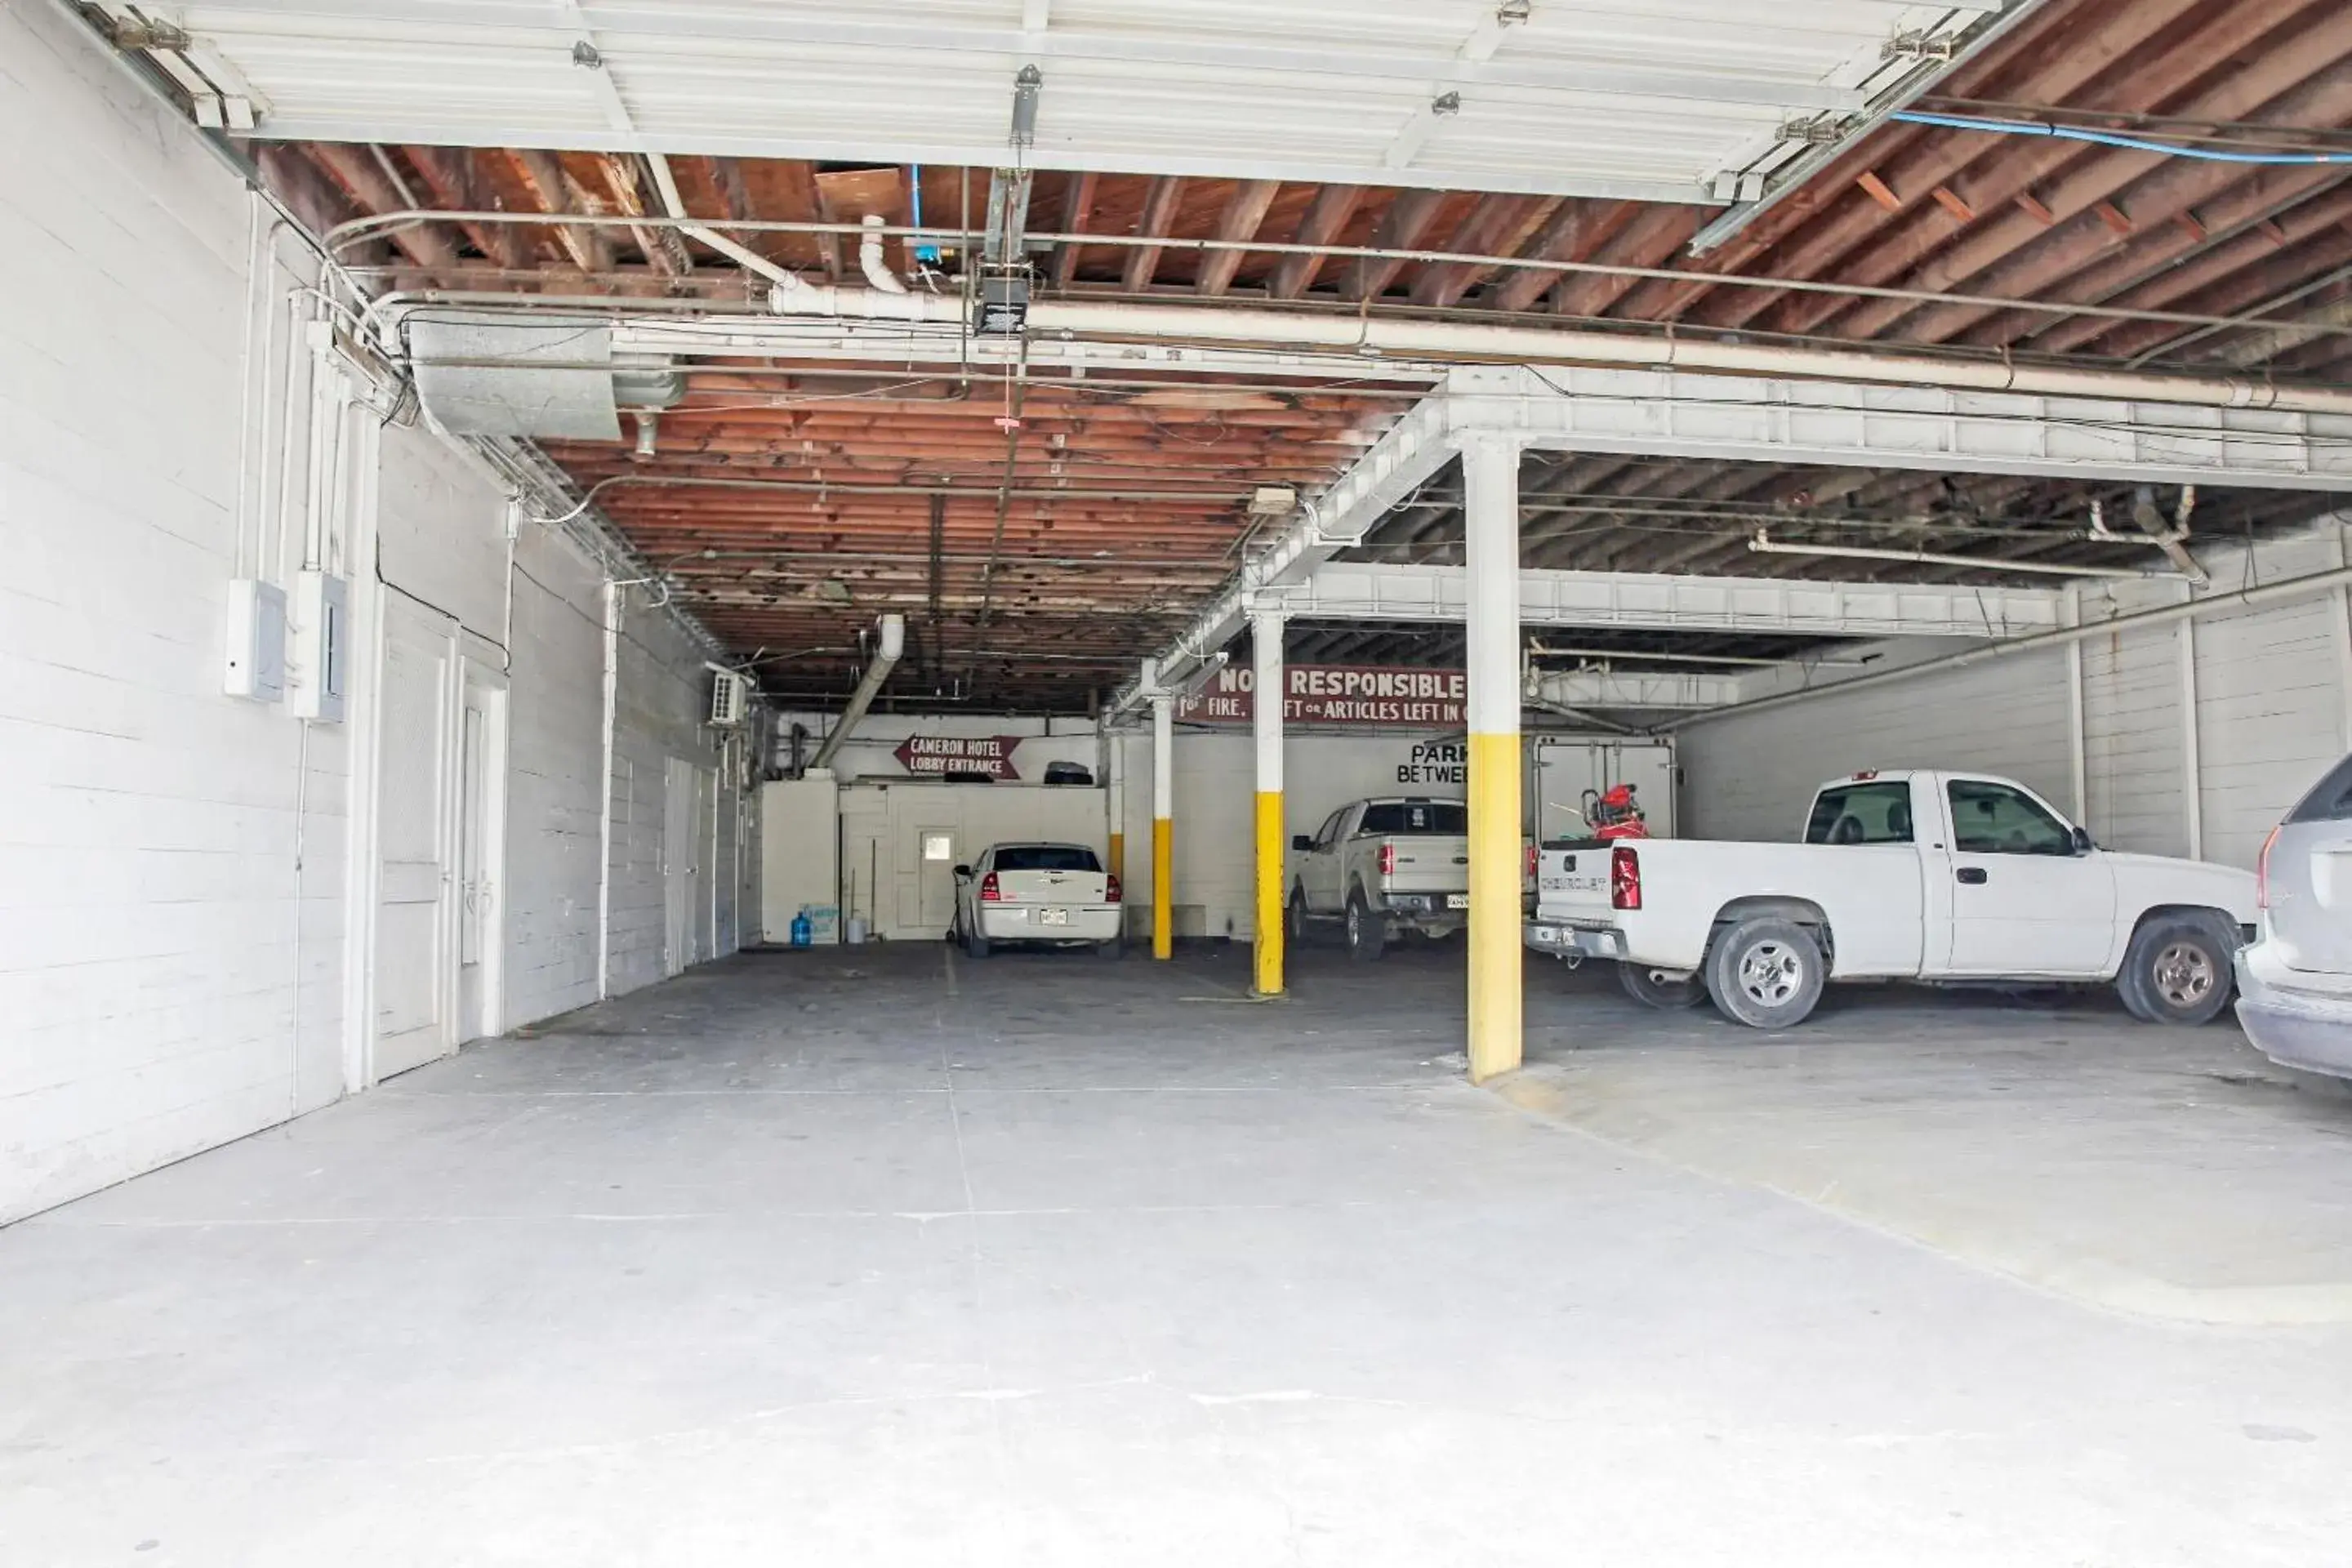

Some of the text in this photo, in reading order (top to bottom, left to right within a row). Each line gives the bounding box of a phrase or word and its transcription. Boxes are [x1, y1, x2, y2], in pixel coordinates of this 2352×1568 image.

[1290, 670, 1465, 698] RESPONSIBLE
[1323, 702, 1400, 720] ARTICLES
[1403, 703, 1439, 720] LEFT
[1444, 705, 1458, 721] IN
[911, 738, 1002, 756] CAMERON HOTEL
[911, 756, 1002, 773] LOBBY ENTRANCE
